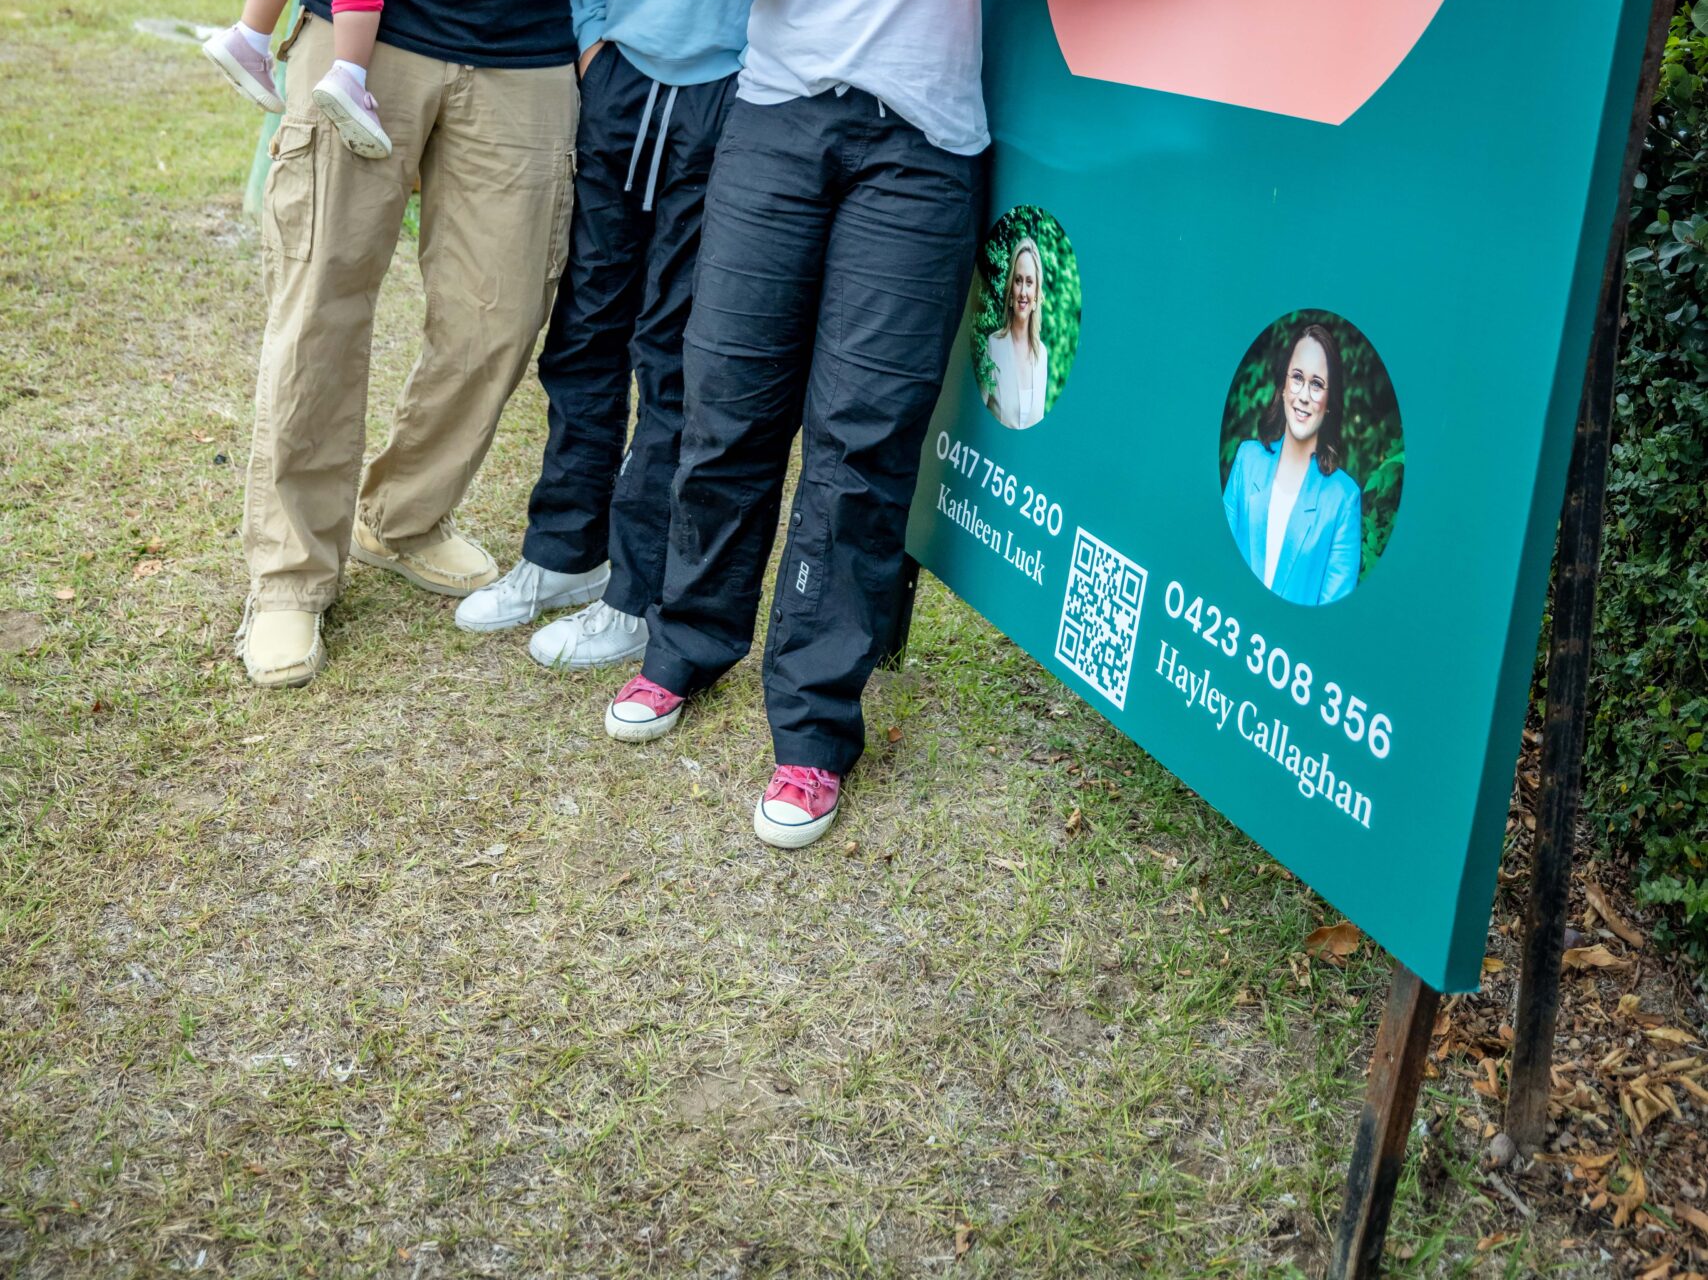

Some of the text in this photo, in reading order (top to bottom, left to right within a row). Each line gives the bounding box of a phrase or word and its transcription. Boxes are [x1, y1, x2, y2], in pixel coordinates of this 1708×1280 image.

[936, 430, 1064, 537] 0417 756 280
[936, 483, 1046, 587] Kathleen Luck
[1155, 640, 1373, 830] Hayley Callaghan
[1164, 579, 1394, 760] 0423 308 356
